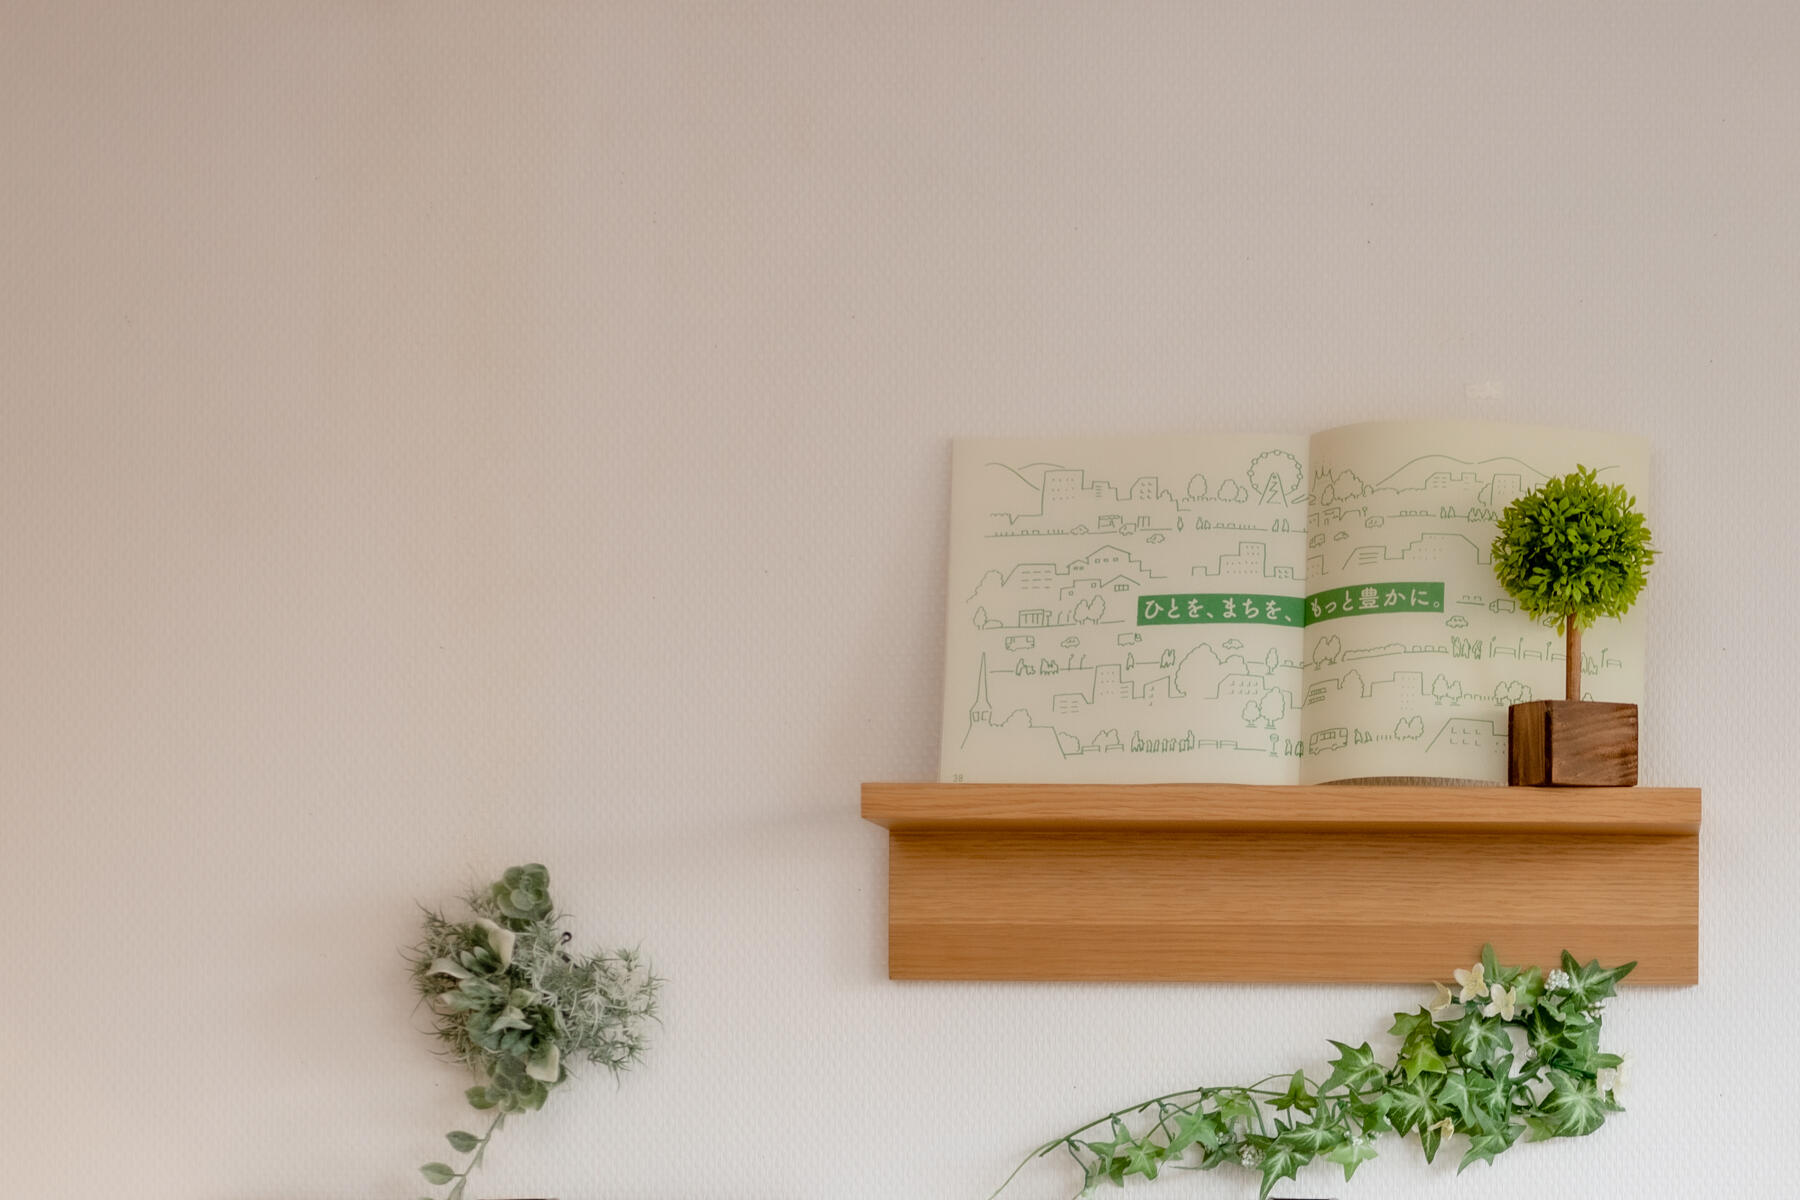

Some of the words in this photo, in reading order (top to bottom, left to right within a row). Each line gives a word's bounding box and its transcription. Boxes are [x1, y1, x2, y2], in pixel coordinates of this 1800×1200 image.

[1144, 586, 1440, 622] ひとを、まちを、もっと豊かに。
